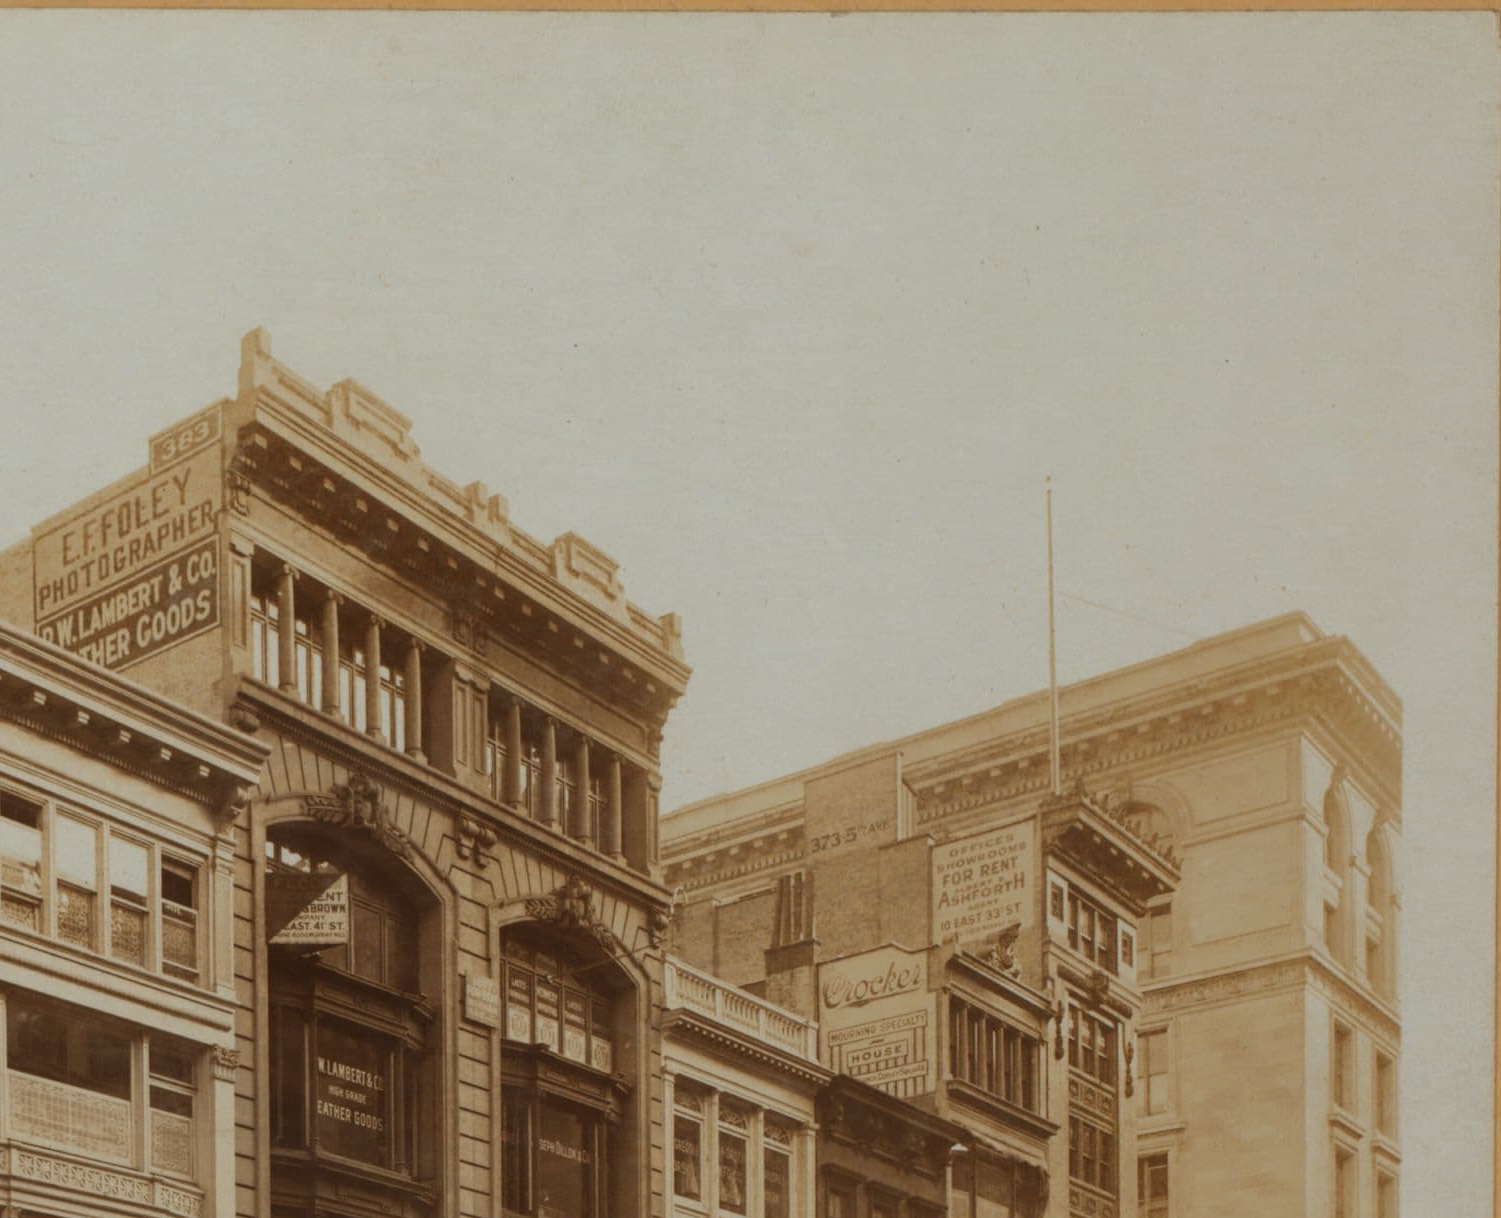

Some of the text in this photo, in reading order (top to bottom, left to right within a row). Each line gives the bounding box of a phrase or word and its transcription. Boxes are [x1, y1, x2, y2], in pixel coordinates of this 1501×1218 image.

[162, 420, 210, 461] 383
[39, 498, 215, 611] PHOTOGRAPHER
[168, 562, 183, 596] &
[185, 549, 216, 585] CO.
[135, 590, 211, 648] GOODS
[811, 831, 841, 854] 373
[937, 841, 1028, 874] SHOWROOMS
[949, 833, 1015, 858] OFFICES
[942, 855, 1019, 889] FOR RENT
[317, 891, 344, 903] NT
[937, 871, 1026, 910] ASHFORTH
[285, 921, 311, 931] AST
[954, 911, 982, 929] EAST
[821, 961, 924, 1009] Crocker
[830, 1023, 877, 1045] MOURNING
[879, 1013, 926, 1033] SPECIALTY
[850, 1044, 905, 1064] HOUSE
[353, 1110, 385, 1132] GOODS
